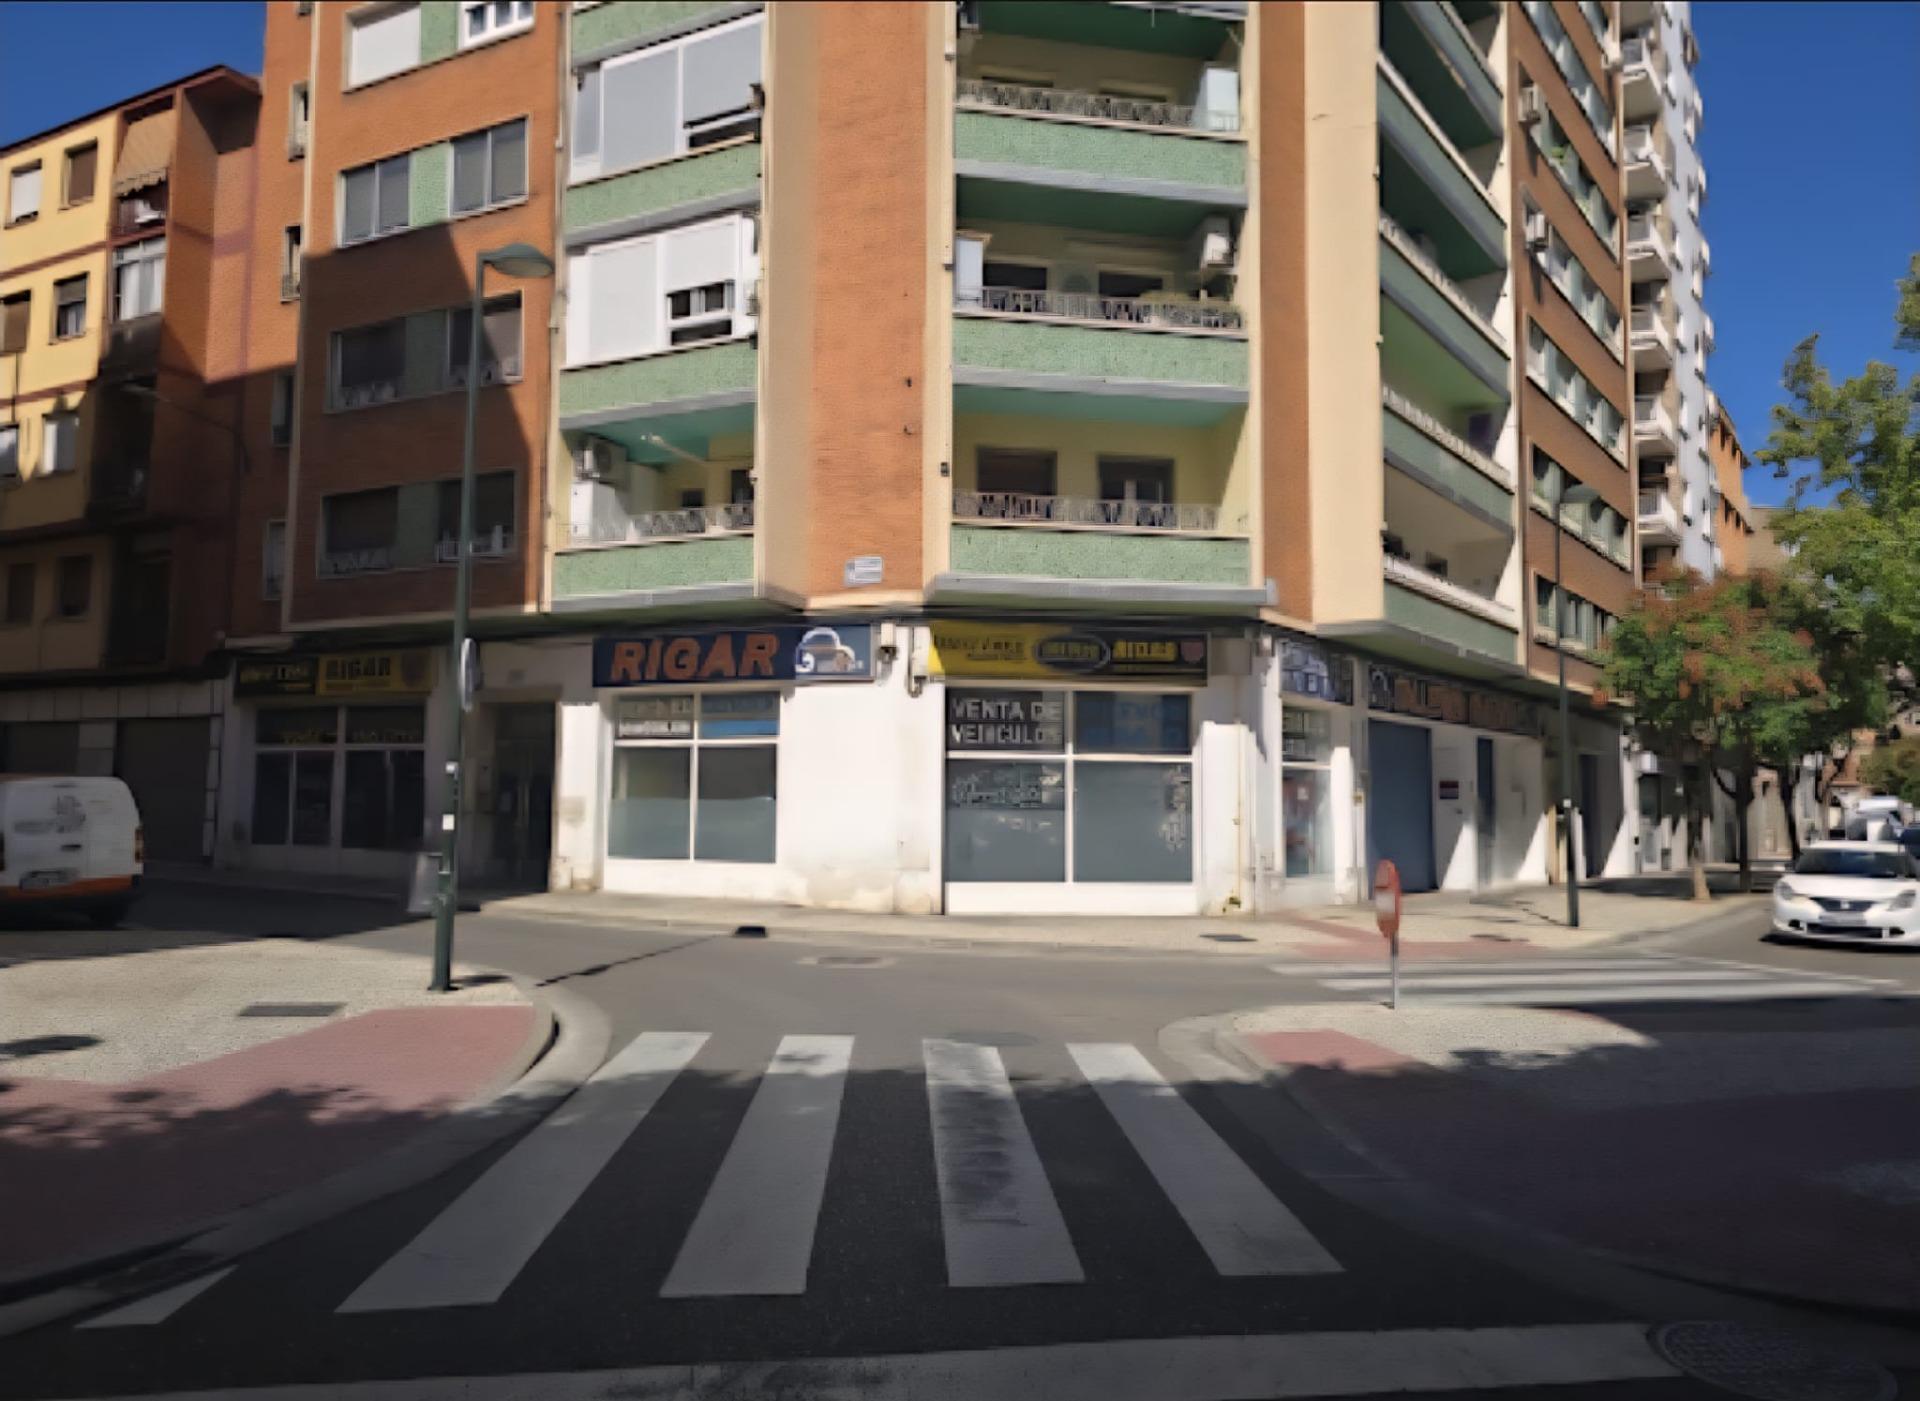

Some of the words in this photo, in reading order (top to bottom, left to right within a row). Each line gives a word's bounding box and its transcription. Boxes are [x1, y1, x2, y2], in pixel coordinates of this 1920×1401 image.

[609, 634, 780, 681] RIGAR
[952, 699, 1024, 720] VENTA
[1031, 701, 1061, 721] DE
